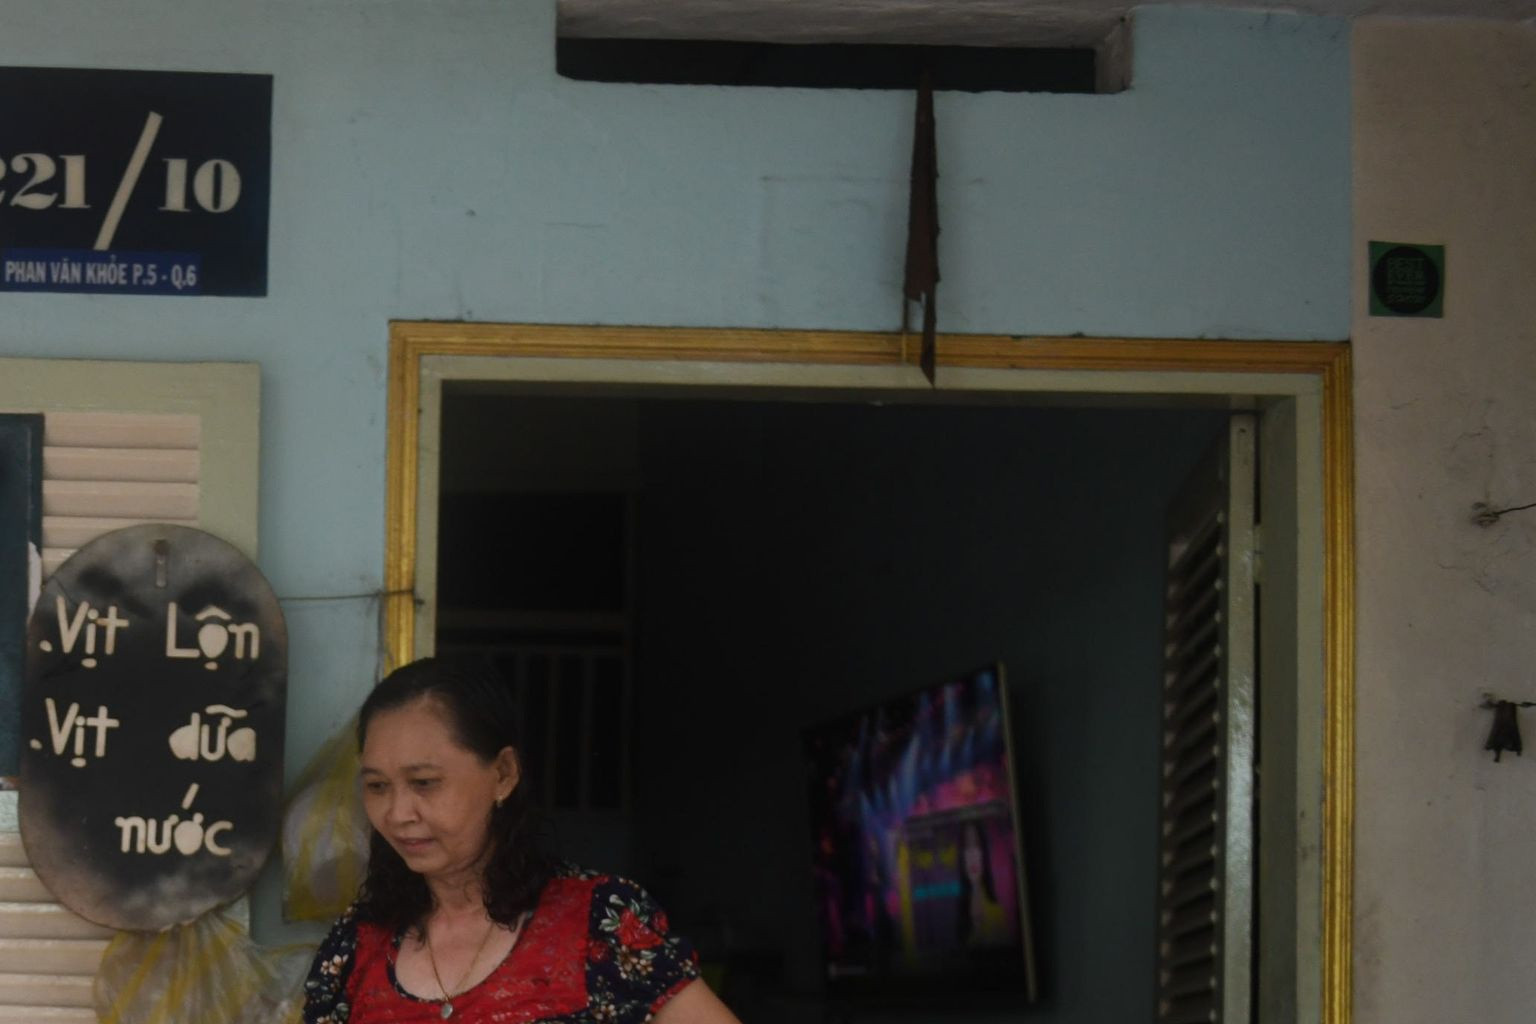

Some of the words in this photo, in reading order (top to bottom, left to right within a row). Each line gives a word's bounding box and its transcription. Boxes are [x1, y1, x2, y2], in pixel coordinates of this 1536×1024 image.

[5, 261, 46, 283] PHAN
[51, 258, 81, 284] VĂN
[133, 264, 157, 285] P.5
[171, 265, 197, 290] Q.6
[166, 602, 260, 670] Lộn
[114, 783, 234, 857] nước
